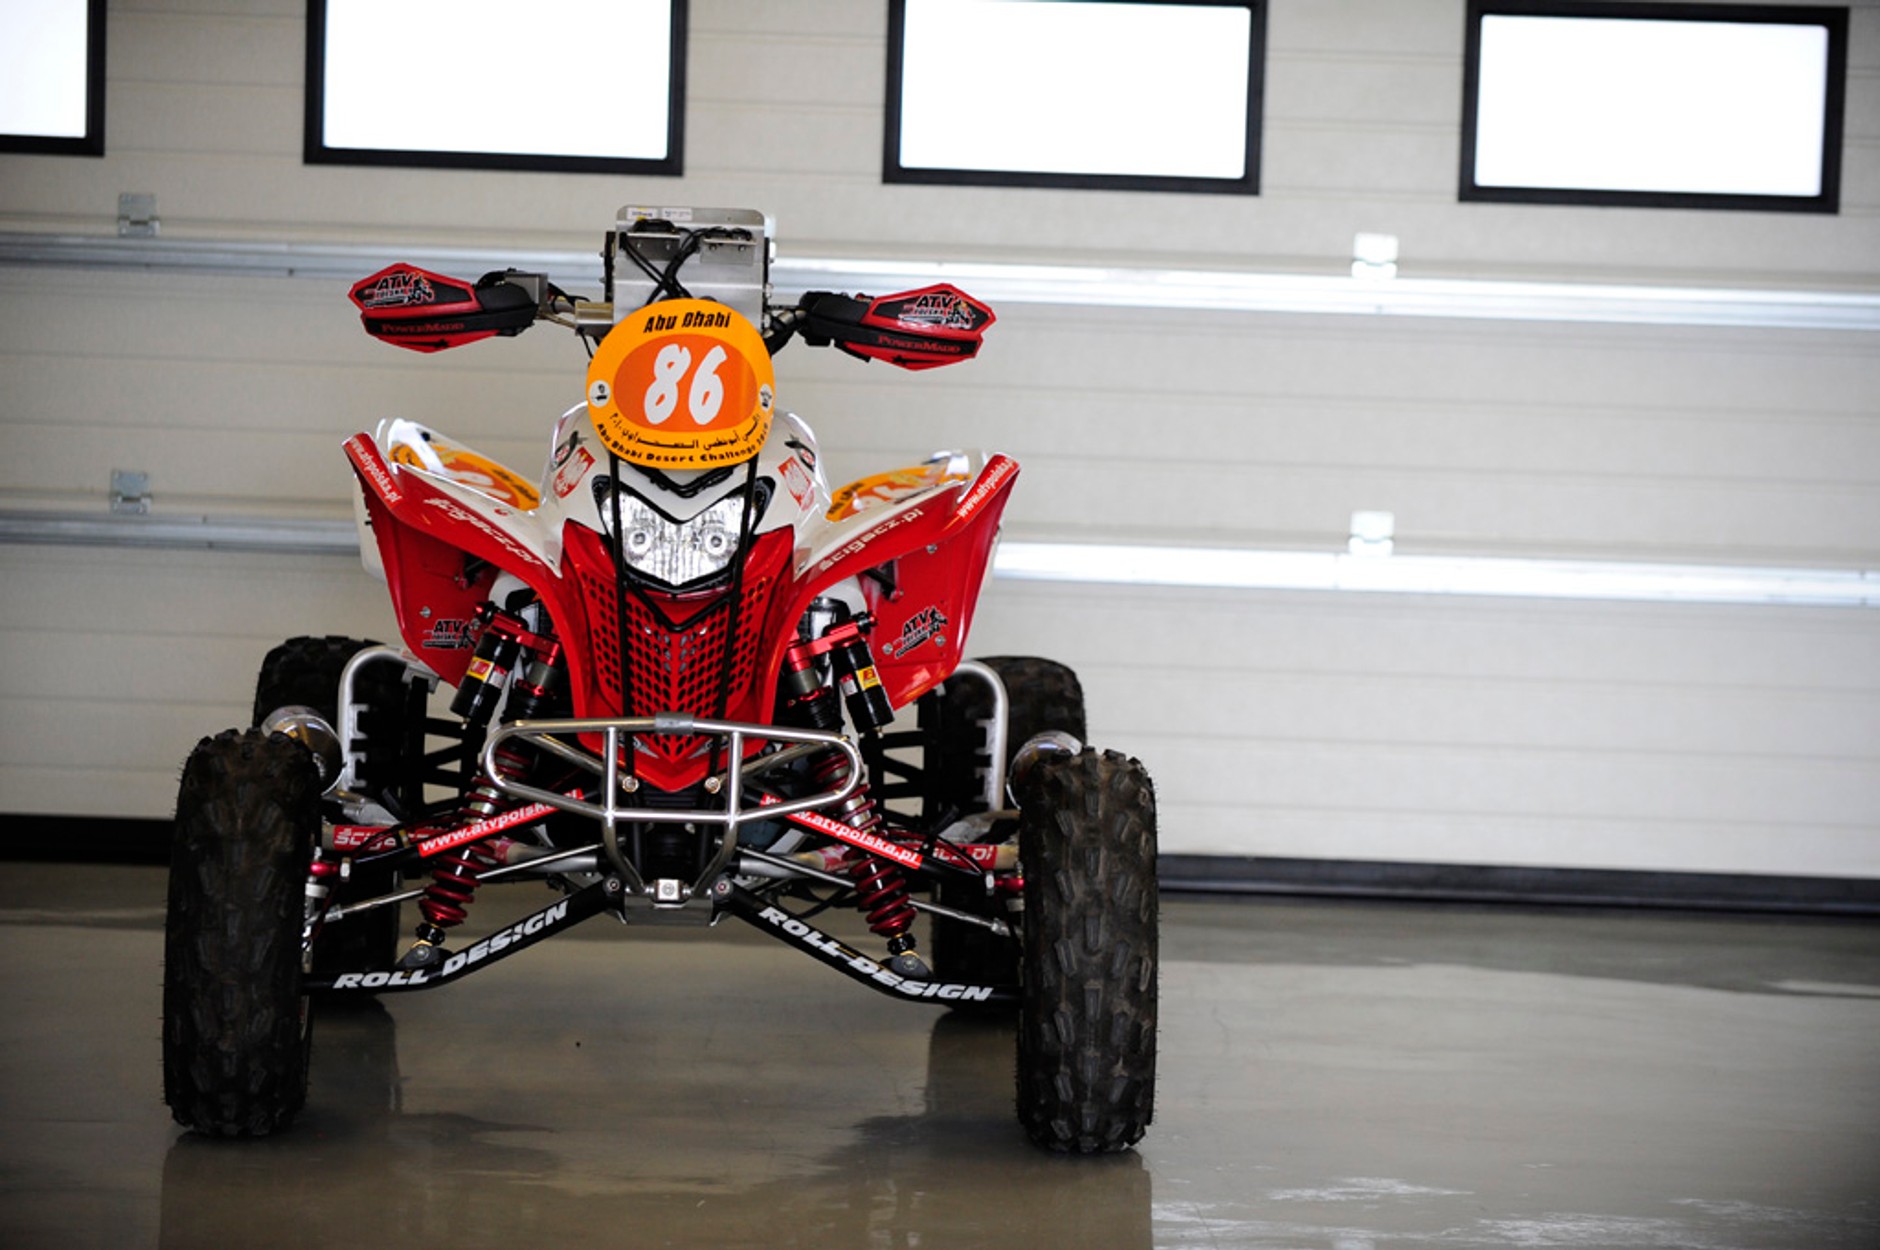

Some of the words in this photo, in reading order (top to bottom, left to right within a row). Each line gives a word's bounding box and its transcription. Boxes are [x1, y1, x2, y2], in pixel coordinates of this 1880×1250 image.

[377, 273, 415, 290] ATV
[915, 294, 956, 308] ATV
[643, 313, 678, 333] Abu
[681, 311, 731, 329] Dhabi
[644, 343, 728, 425] 86
[646, 452, 694, 462] Desert
[700, 443, 756, 462] Challenge
[434, 619, 463, 632] ATV
[902, 606, 930, 637] ATV
[332, 969, 430, 988] ROLL
[442, 901, 569, 976] DESIGN
[758, 906, 847, 957] ROLL
[849, 955, 994, 1001] DESIGN
